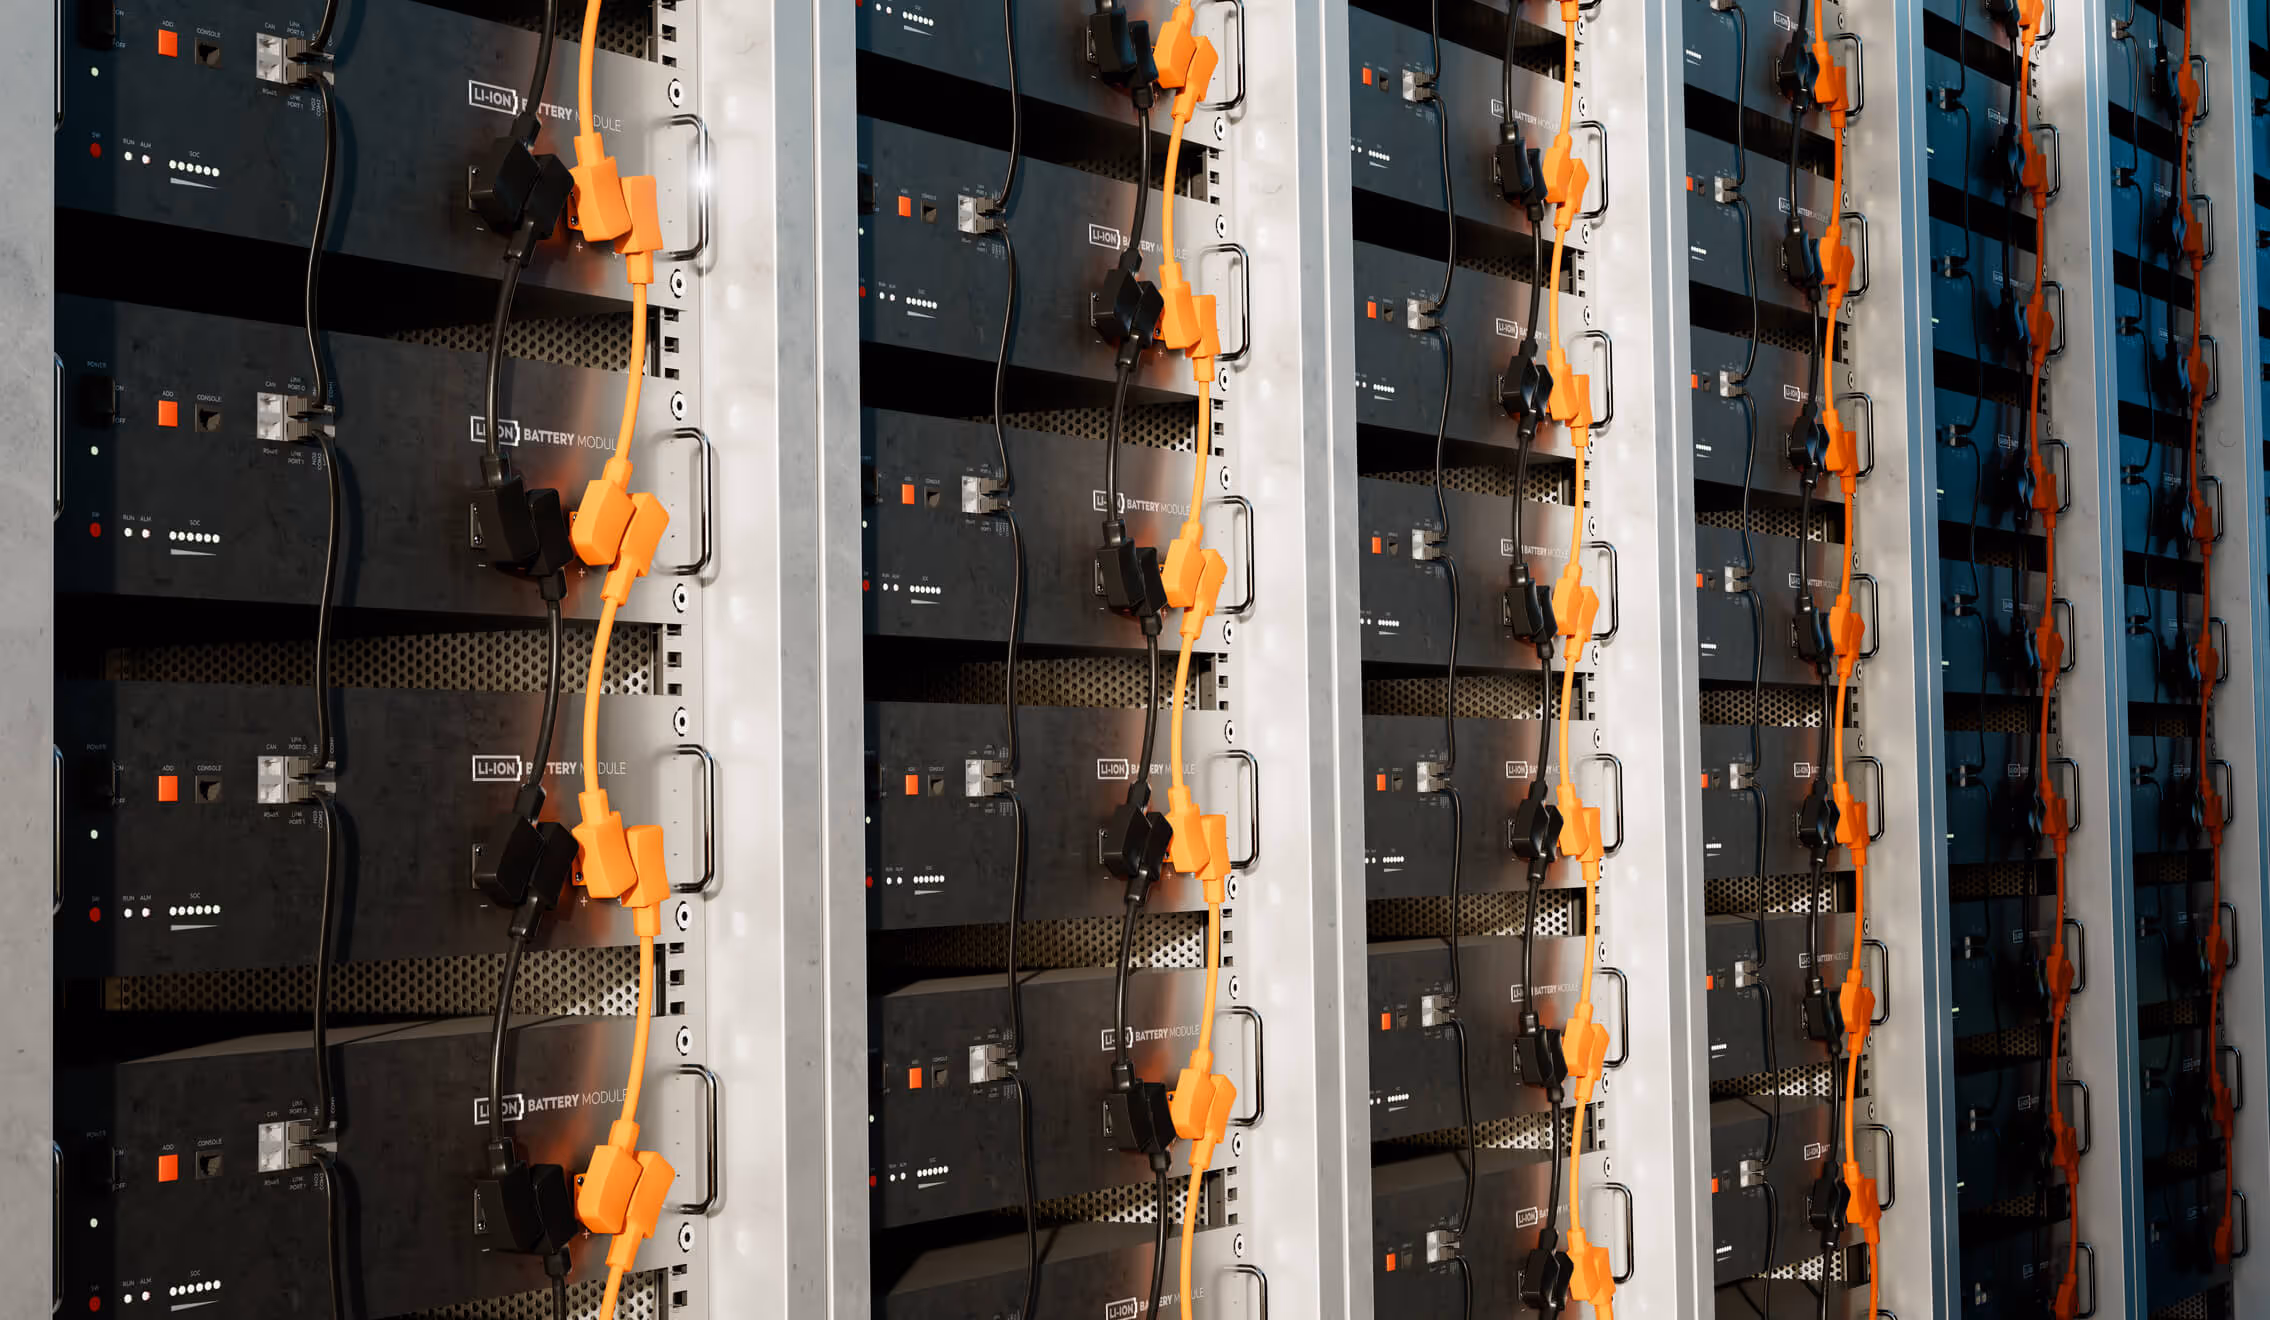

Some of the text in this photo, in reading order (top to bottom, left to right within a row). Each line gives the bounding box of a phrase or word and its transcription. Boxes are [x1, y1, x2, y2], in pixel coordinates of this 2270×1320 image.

[264, 22, 276, 31] CAN
[286, 27, 299, 36] PORT
[196, 28, 222, 39] CONSOLE
[474, 87, 512, 108] LI-ION
[575, 110, 622, 132] MDULE
[1092, 230, 1118, 244] LI-ION
[196, 393, 223, 403] CONSOLE
[523, 427, 576, 447] BATTERY
[577, 434, 618, 452] MODUL
[1126, 499, 1159, 512] BATTERY
[122, 513, 136, 522] RUN
[265, 743, 278, 751] CAN
[196, 764, 223, 772] CONSOLE
[478, 762, 516, 775] LI-ION
[1100, 764, 1125, 775] LI-ION
[140, 894, 153, 902] ALM
[1135, 1029, 1168, 1042] BATTERY
[1169, 1024, 1200, 1039] MODULE
[527, 1093, 580, 1113] BATTERY
[197, 1138, 223, 1147] CONSOLE
[140, 1278, 153, 1286] ALM
[1109, 1303, 1134, 1319] LI-ION
